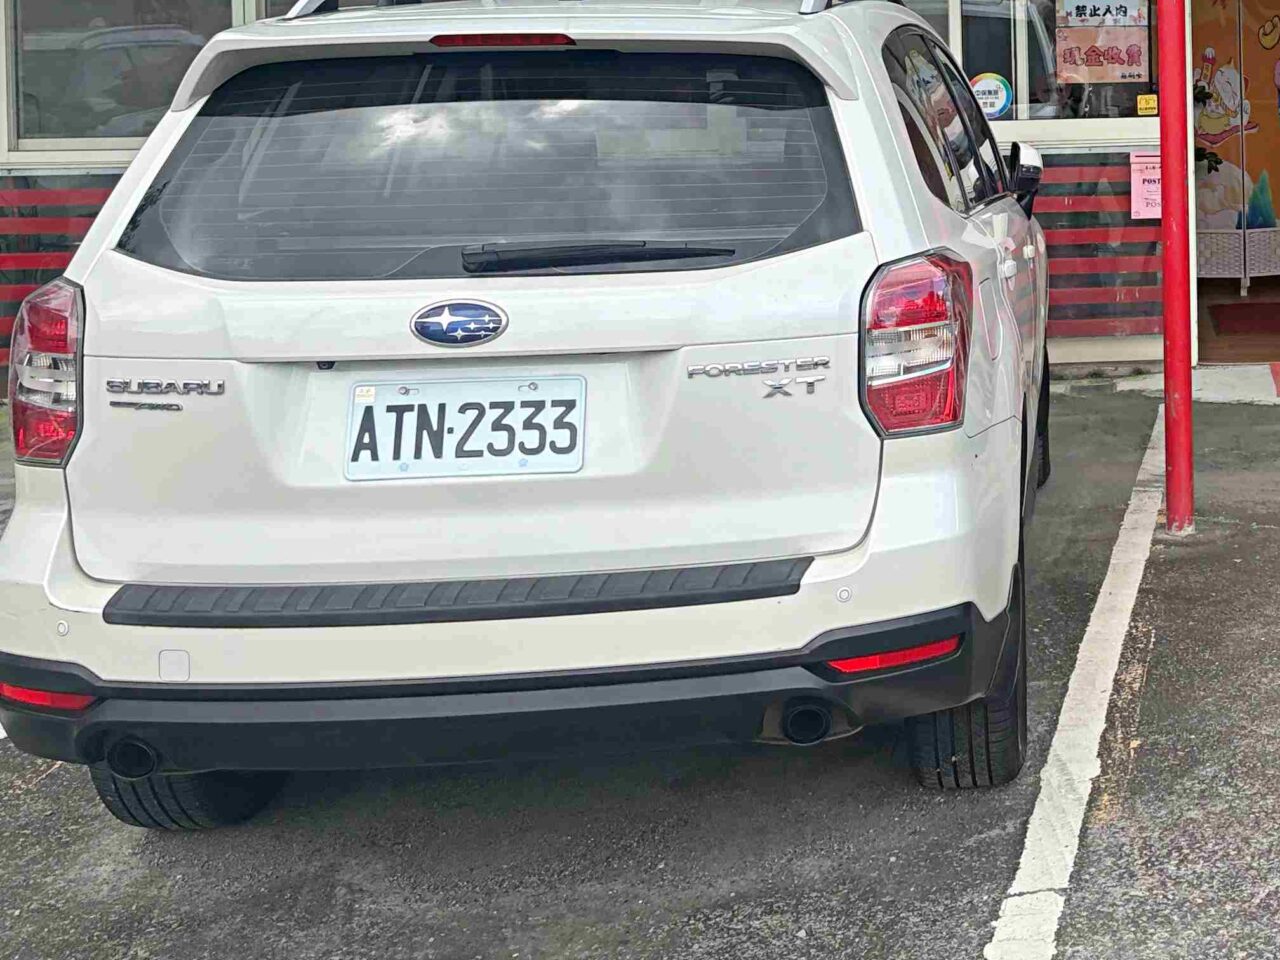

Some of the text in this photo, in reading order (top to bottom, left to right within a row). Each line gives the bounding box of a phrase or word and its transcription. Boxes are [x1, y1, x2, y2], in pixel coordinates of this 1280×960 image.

[1062, 43, 1143, 67] 現金收費
[687, 355, 831, 379] FORESTER
[106, 379, 225, 396] SUBARU
[763, 375, 826, 399] XT
